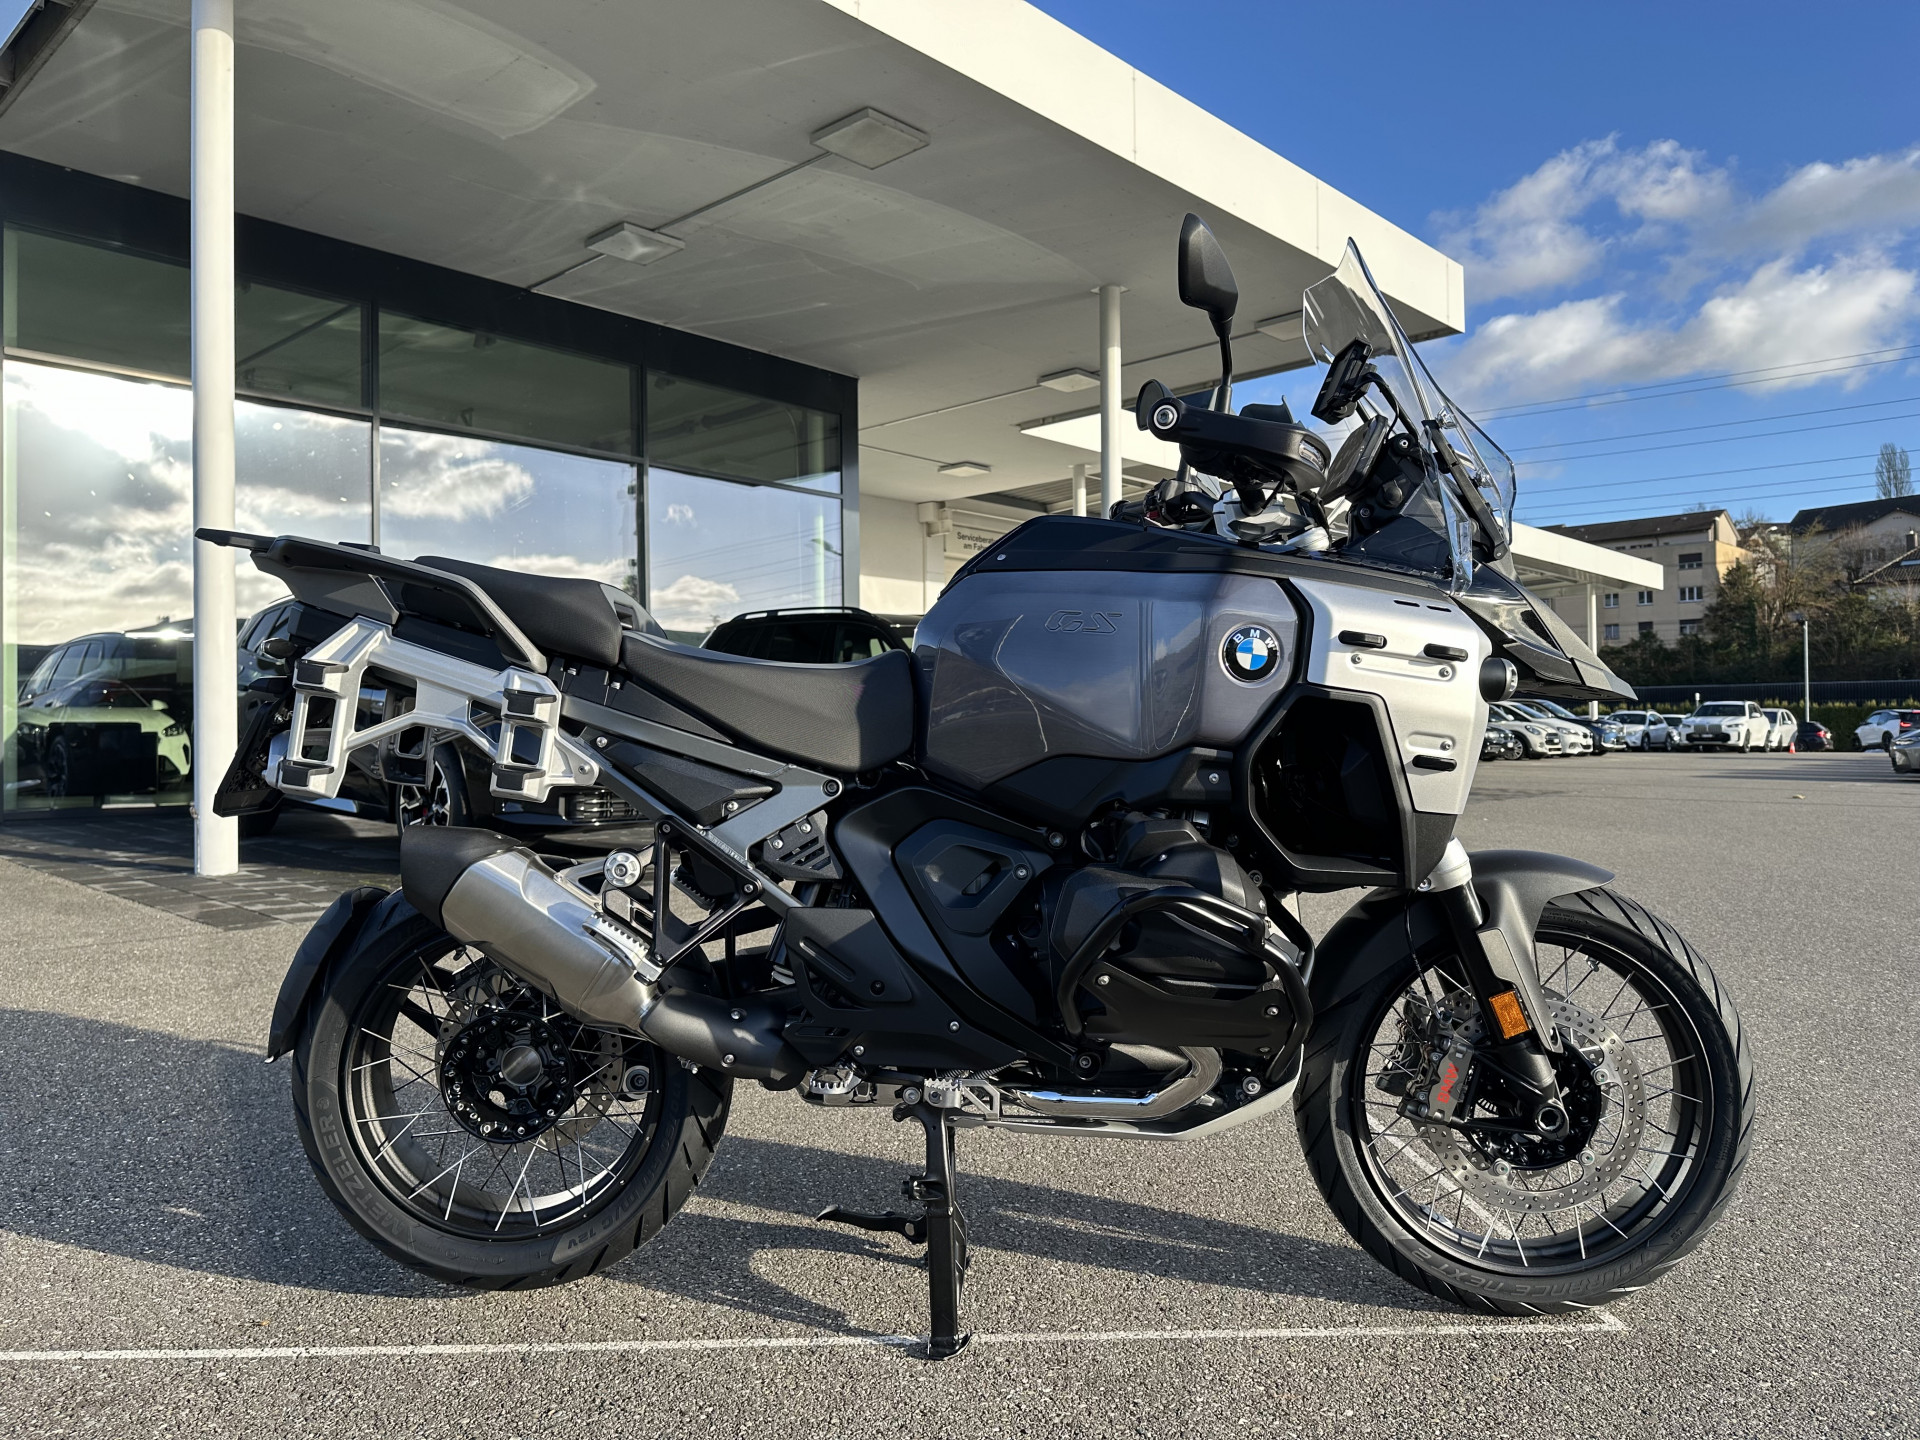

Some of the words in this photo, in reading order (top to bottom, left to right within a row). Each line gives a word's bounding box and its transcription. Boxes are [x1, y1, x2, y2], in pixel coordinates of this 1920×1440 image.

[1045, 610, 1123, 635] GS
[1233, 629, 1277, 650] BMW
[1437, 1062, 1459, 1104] BMW
[318, 1114, 405, 1237] METZELER
[1411, 1247, 1430, 1262] 2
[1430, 1261, 1504, 1292] NEXT
[1510, 1251, 1647, 1298] TOURANCE
